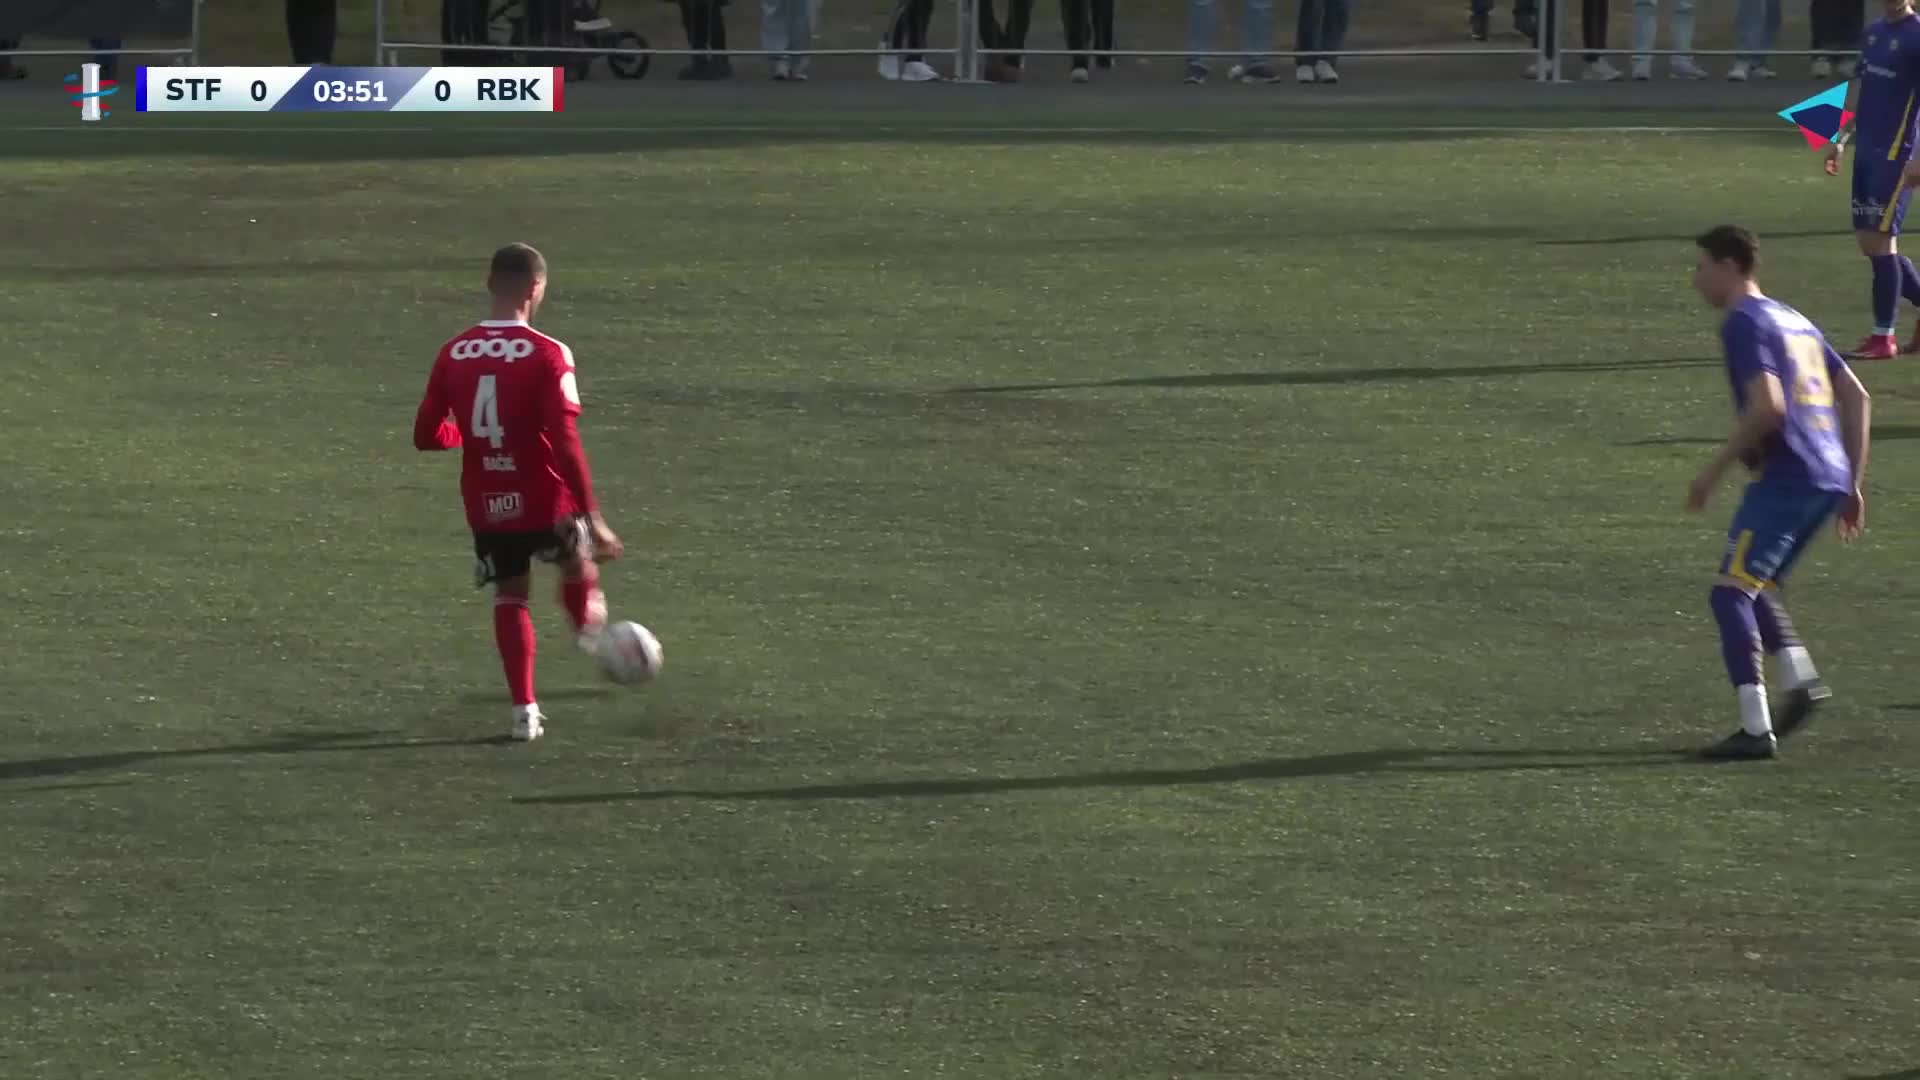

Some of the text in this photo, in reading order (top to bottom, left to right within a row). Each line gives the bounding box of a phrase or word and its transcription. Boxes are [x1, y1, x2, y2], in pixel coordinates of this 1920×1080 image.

[450, 338, 535, 363] coop
[470, 374, 505, 449] 4
[488, 492, 521, 514] MOT
